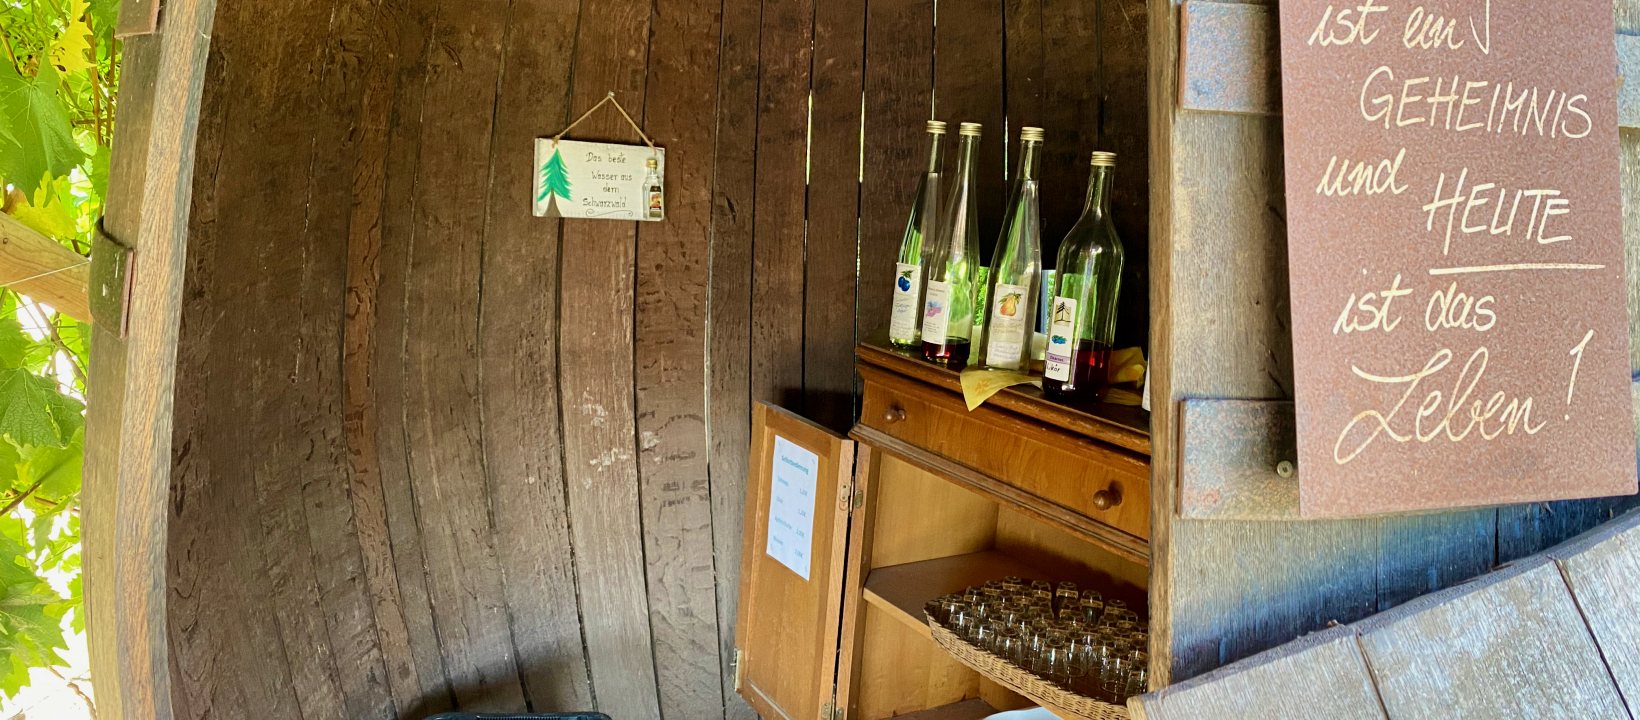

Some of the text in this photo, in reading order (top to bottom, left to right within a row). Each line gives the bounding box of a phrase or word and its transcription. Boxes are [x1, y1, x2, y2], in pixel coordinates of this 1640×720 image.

[1307, 0, 1388, 46] ist
[1403, 6, 1464, 49] ein
[1360, 66, 1592, 140] GEHEIMNIS
[585, 152, 626, 163] Das beste
[591, 170, 617, 181] Wasser
[602, 182, 620, 193] dem
[582, 195, 627, 208] Schwarzwald
[1316, 148, 1572, 255] und HEUTE
[1333, 268, 1496, 335] ist das
